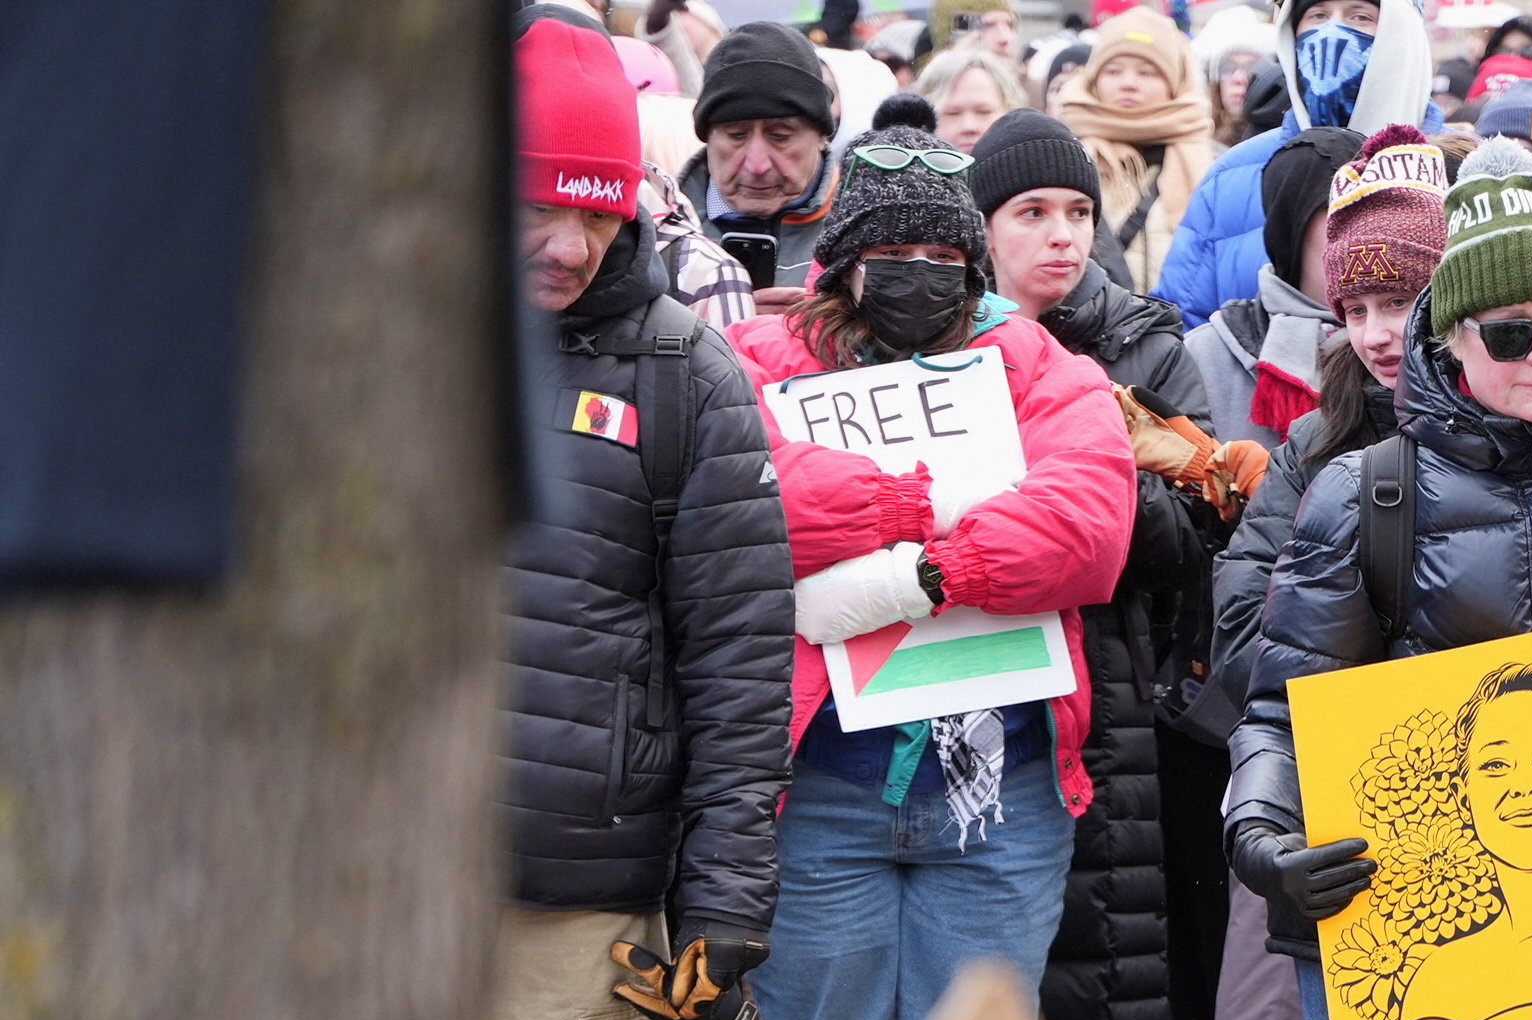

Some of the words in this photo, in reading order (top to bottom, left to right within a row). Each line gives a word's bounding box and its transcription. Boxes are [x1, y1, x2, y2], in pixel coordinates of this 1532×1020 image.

[556, 171, 625, 203] LANDBACK
[1341, 243, 1398, 285] M
[799, 378, 968, 449] FREE
